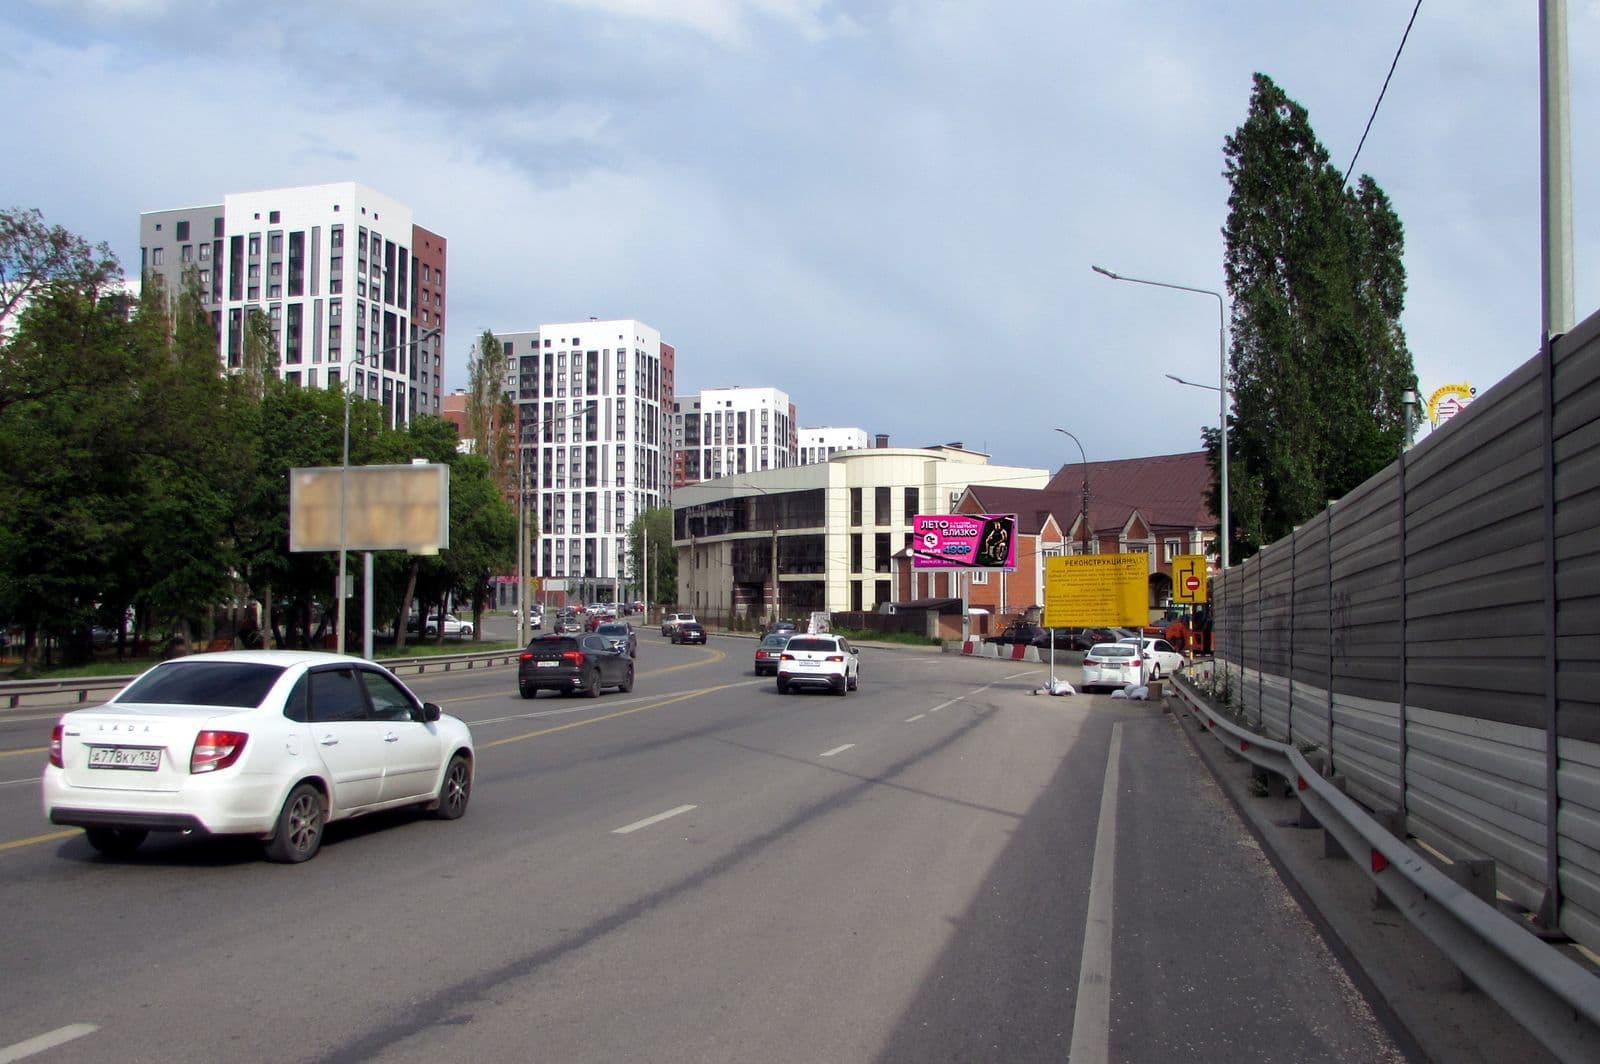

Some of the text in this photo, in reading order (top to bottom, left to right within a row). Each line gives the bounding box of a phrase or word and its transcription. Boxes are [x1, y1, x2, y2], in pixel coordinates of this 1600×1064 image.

[921, 520, 949, 529] ЛЕТО
[942, 528, 978, 536] БЛИЗКО
[99, 724, 150, 732] LADA
[139, 751, 157, 762] 136
